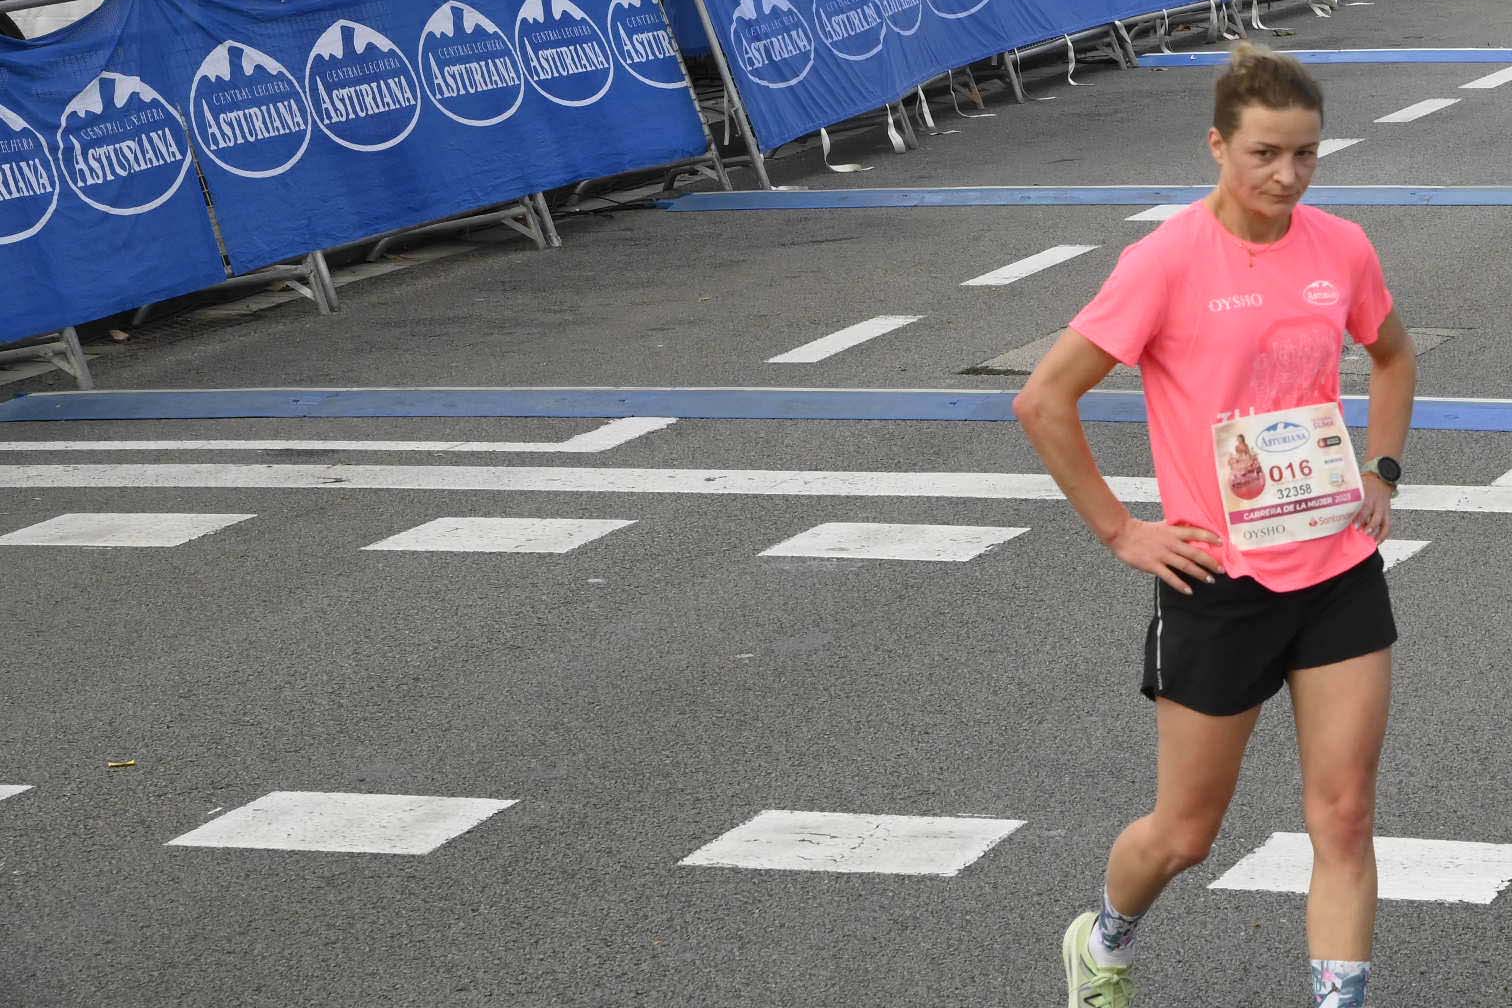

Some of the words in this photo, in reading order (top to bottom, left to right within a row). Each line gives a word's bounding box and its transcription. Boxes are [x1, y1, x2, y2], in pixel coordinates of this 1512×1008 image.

[524, 36, 609, 81] ASTURIANA
[428, 52, 521, 100] ASTURIANA
[316, 75, 417, 125] ASTURIANA
[202, 97, 306, 151] ASTURIANA
[1208, 293, 1264, 312] OYSHO
[1269, 459, 1313, 483] 016
[1277, 483, 1313, 500] 32358
[1243, 506, 1282, 520] CARRERA
[1283, 503, 1295, 512] DE
[1296, 501, 1306, 511] LA
[1307, 496, 1333, 508] MUJER
[1243, 524, 1286, 540] OYSHO
